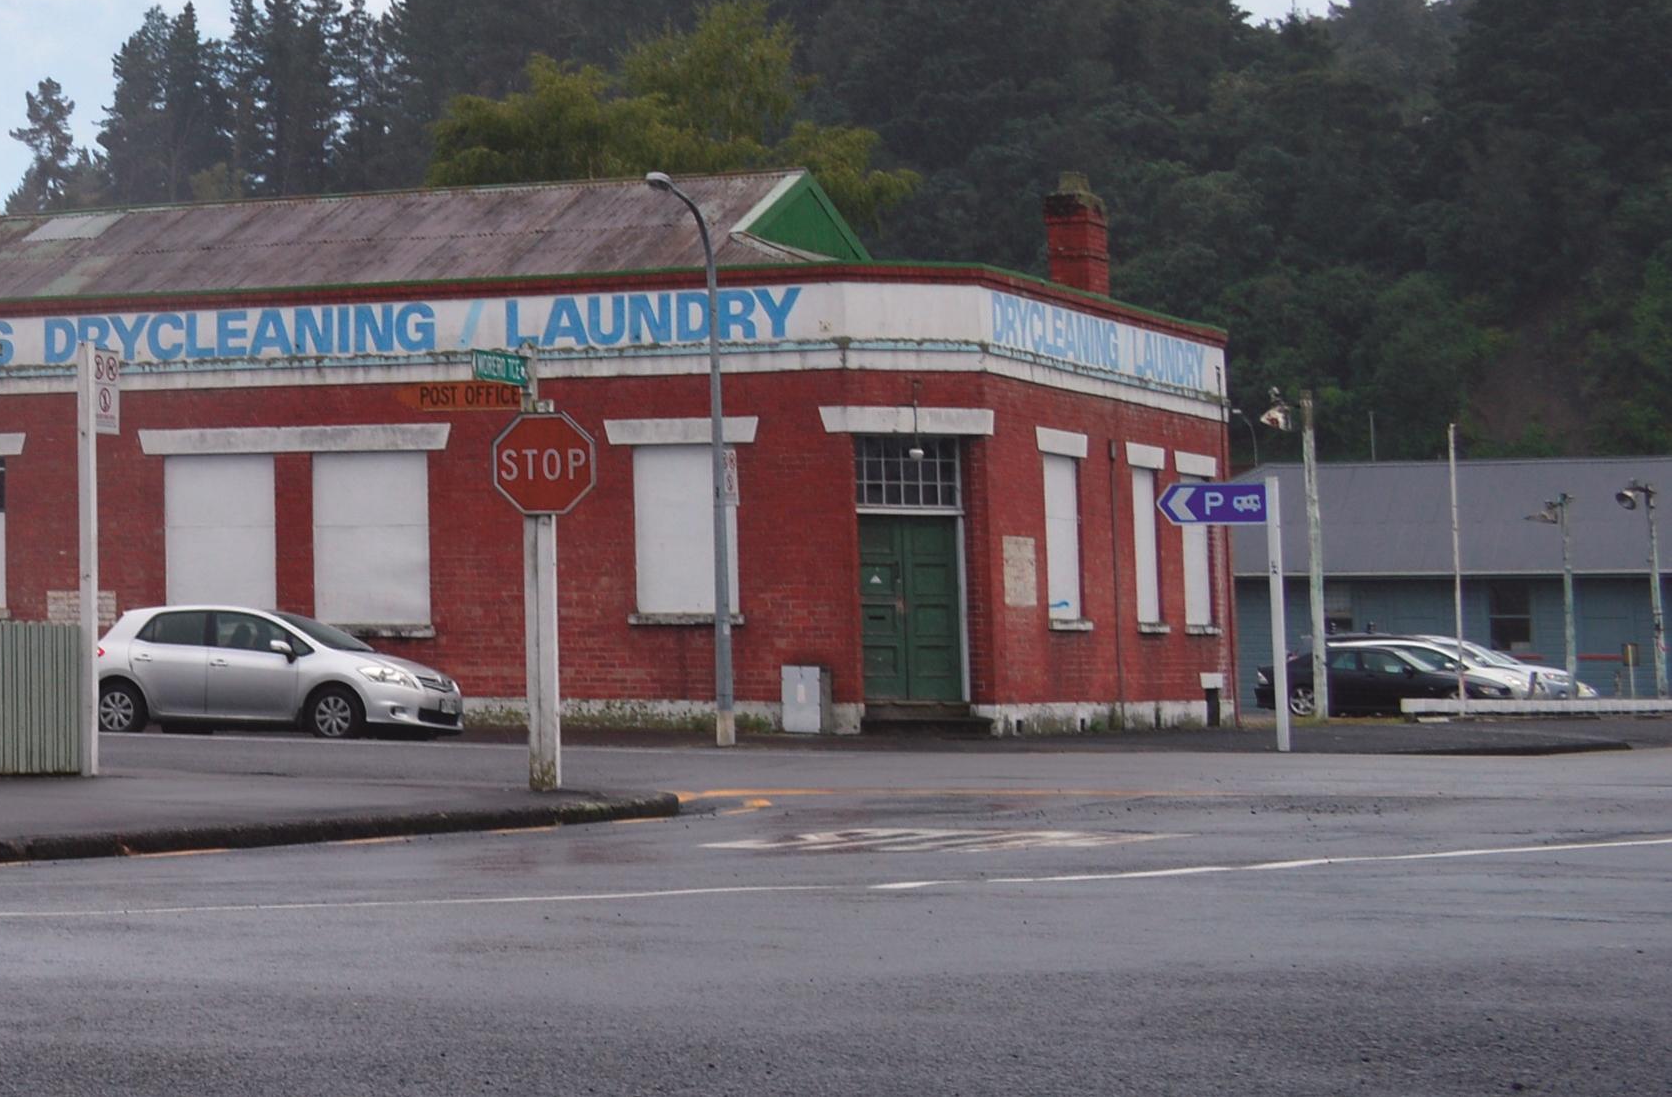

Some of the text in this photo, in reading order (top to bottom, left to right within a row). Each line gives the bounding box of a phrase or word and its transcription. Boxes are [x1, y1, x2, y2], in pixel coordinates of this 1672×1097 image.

[43, 303, 435, 363] DRYCLEANING
[505, 287, 803, 348] LAUNDRY
[992, 291, 1119, 370] DRYCLEANING
[1132, 329, 1205, 390] LAUNDRY
[419, 385, 520, 406] POST OFFICE
[501, 448, 586, 481] STOP
[1204, 492, 1224, 515] P
